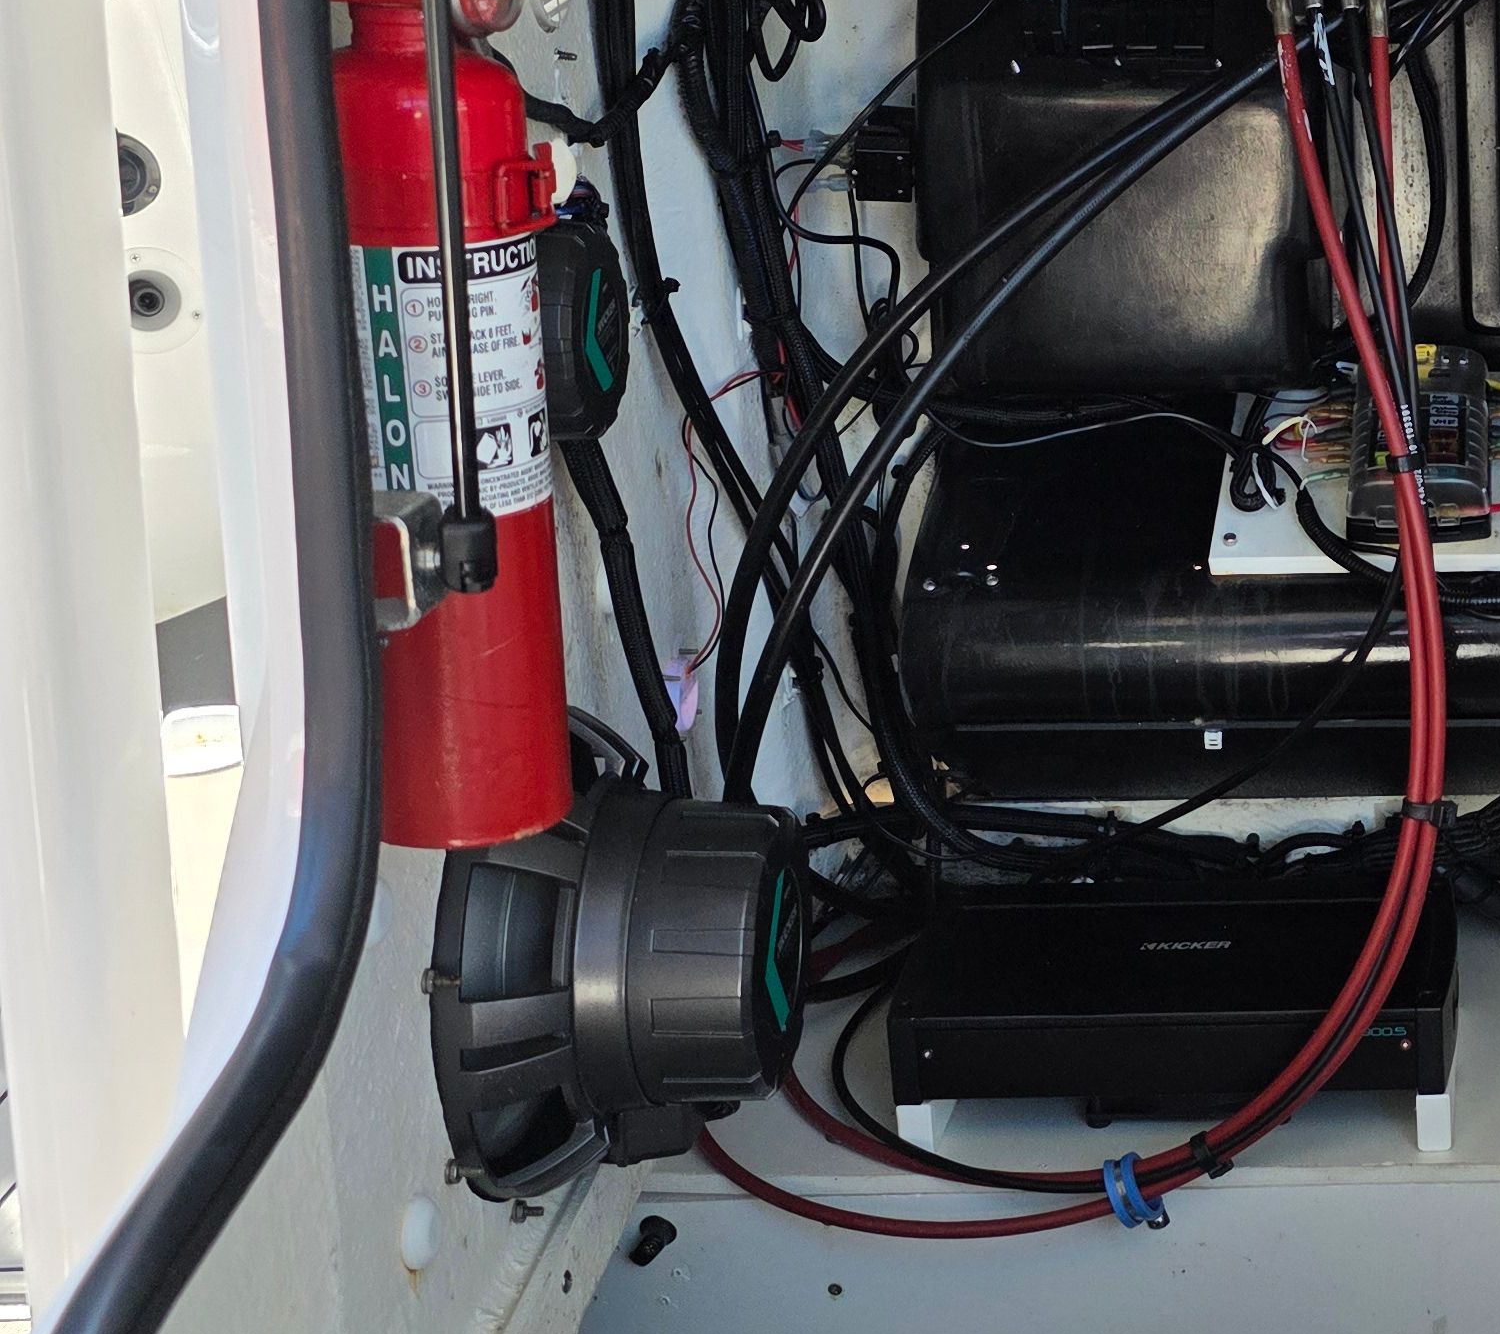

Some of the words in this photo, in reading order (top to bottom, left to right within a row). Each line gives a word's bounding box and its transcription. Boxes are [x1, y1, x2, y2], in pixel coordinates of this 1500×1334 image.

[406, 237, 537, 279] INRUCTIO
[473, 342, 491, 355] ASE
[491, 340, 501, 352] OF
[371, 283, 411, 491] HALON
[493, 382, 503, 395] TO
[1155, 940, 1232, 950] KICKER
